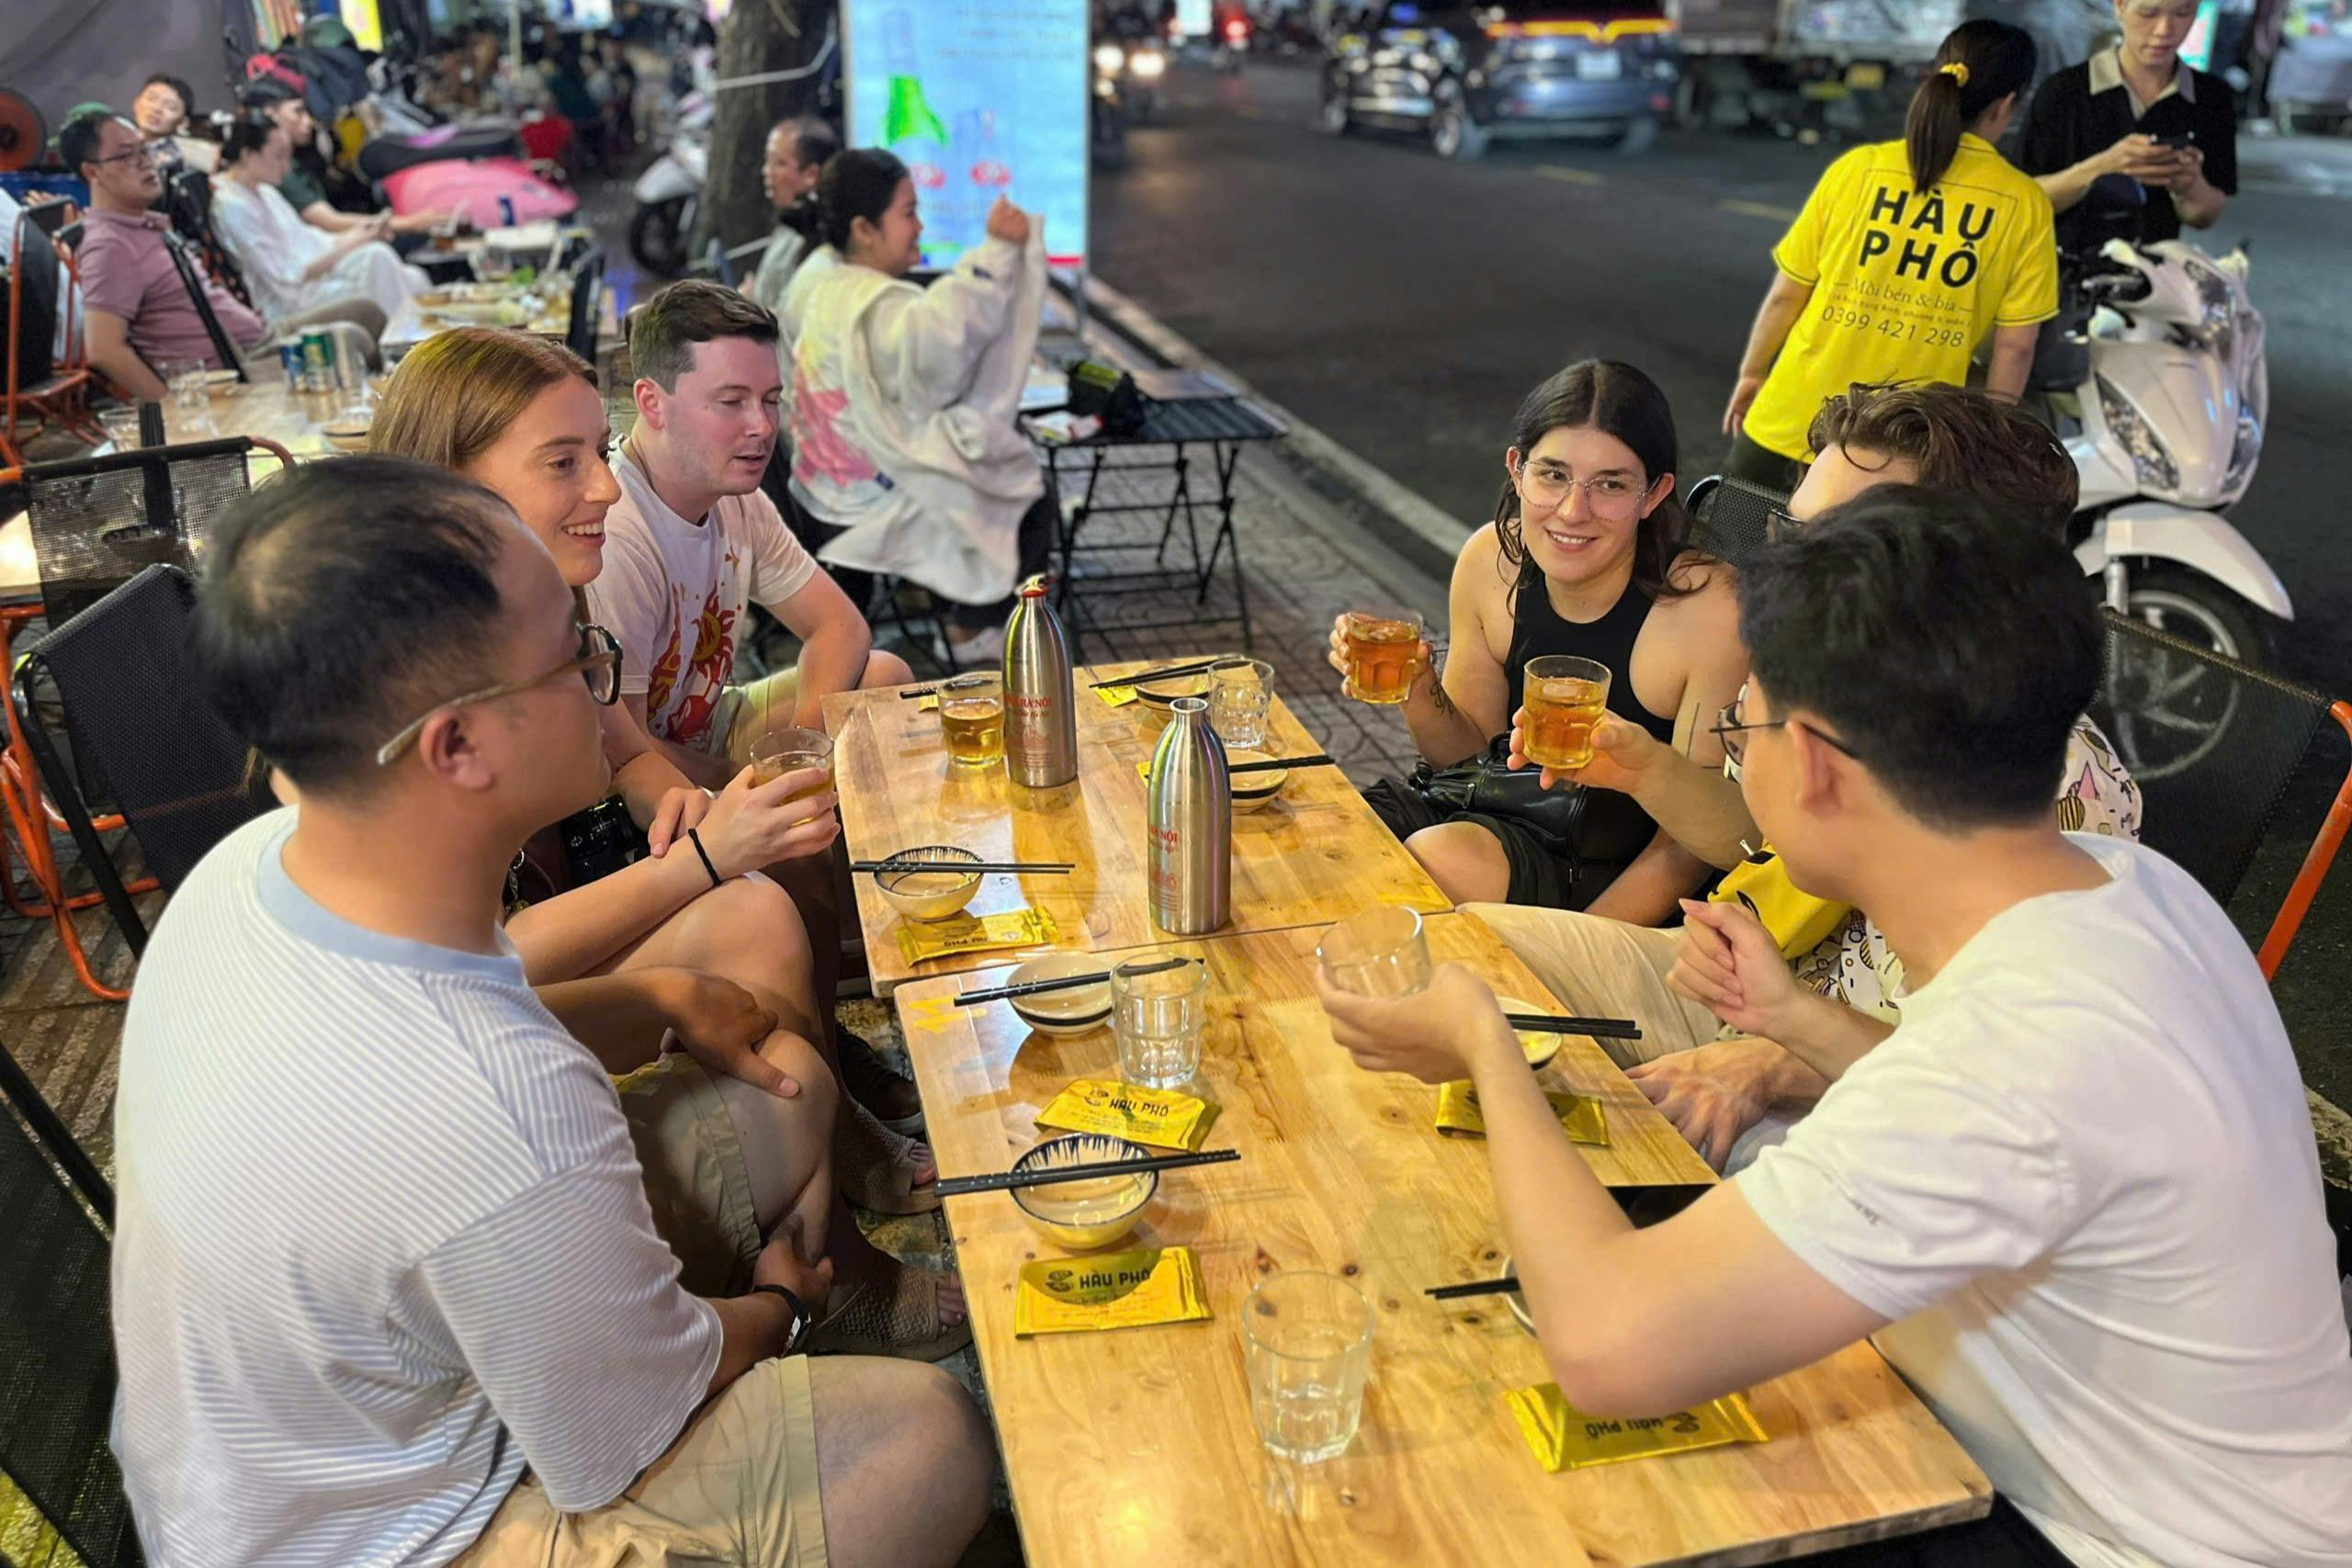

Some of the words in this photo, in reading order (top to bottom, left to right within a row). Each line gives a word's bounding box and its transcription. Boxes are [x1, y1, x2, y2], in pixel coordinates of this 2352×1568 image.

[1916, 294, 1929, 308] &
[1822, 306, 1871, 331] 0399
[1877, 319, 1917, 341] 421
[1924, 327, 1964, 347] 298
